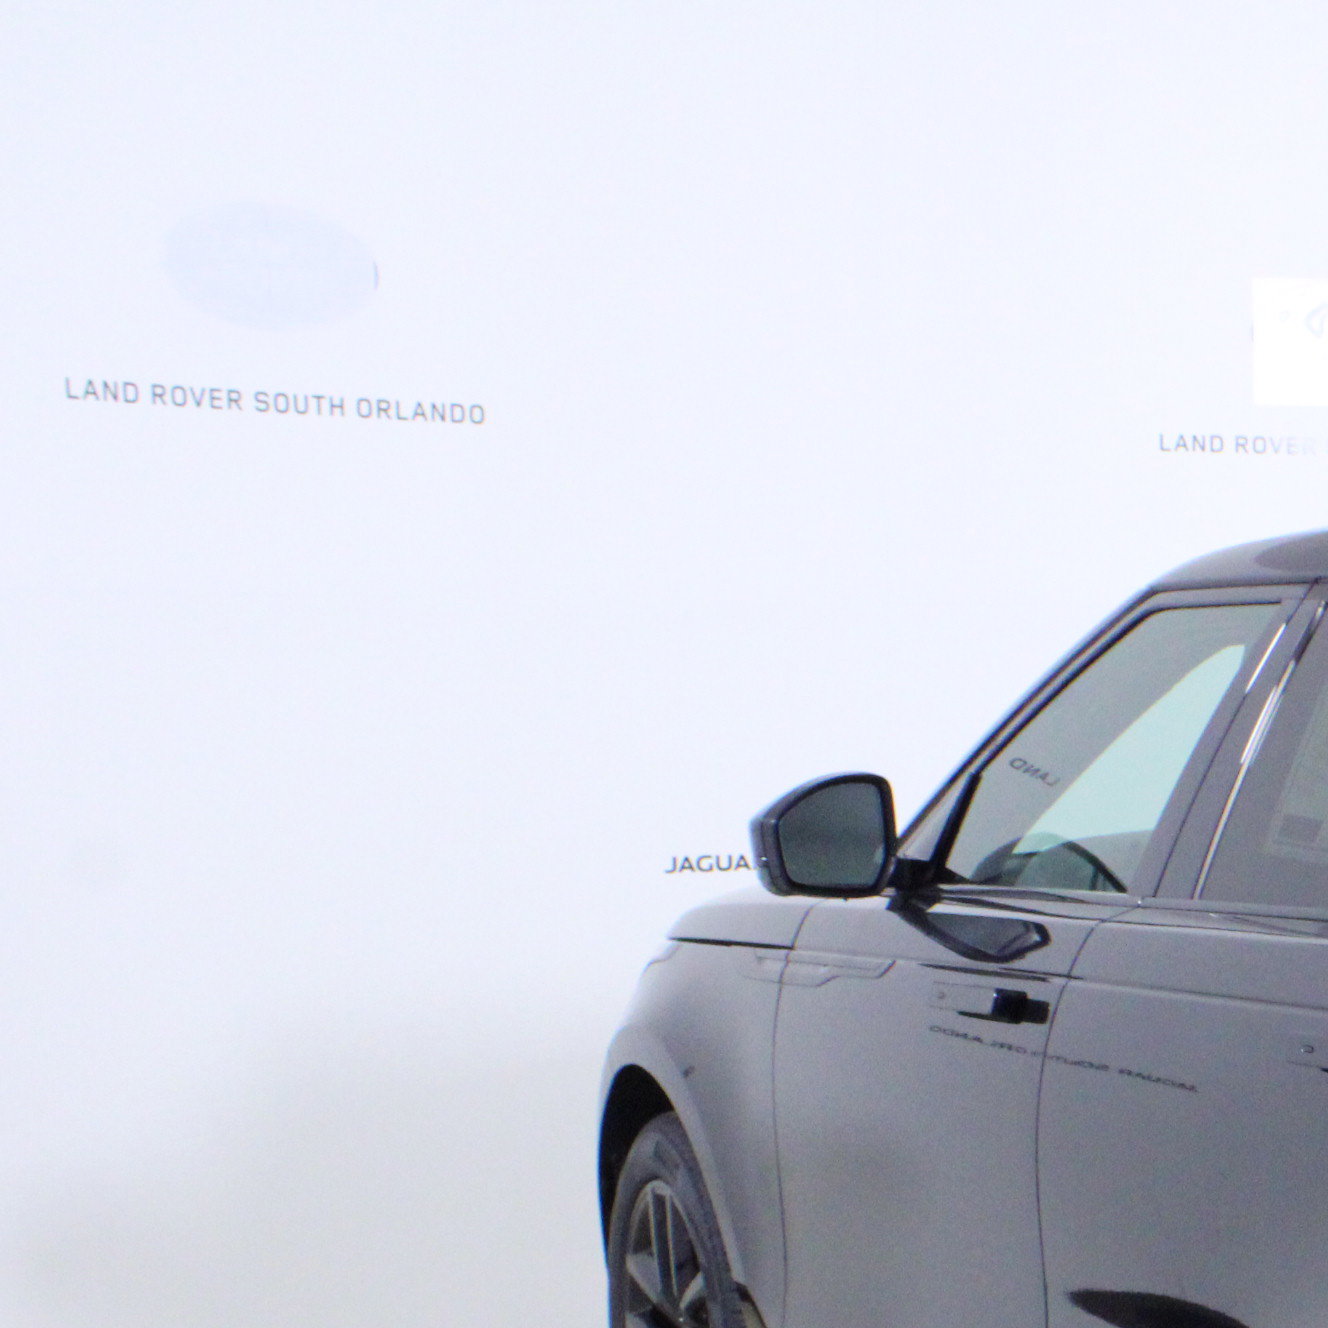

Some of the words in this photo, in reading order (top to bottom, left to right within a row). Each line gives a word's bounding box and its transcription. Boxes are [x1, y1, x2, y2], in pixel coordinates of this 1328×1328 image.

[64, 376, 140, 405] LAND
[150, 383, 244, 412] ROVER
[253, 390, 346, 417] SOUTH
[356, 397, 486, 425] ORLANDO
[1158, 432, 1225, 454] LAND
[1234, 435, 1317, 457] ROVER
[664, 853, 757, 874] JAGUA
